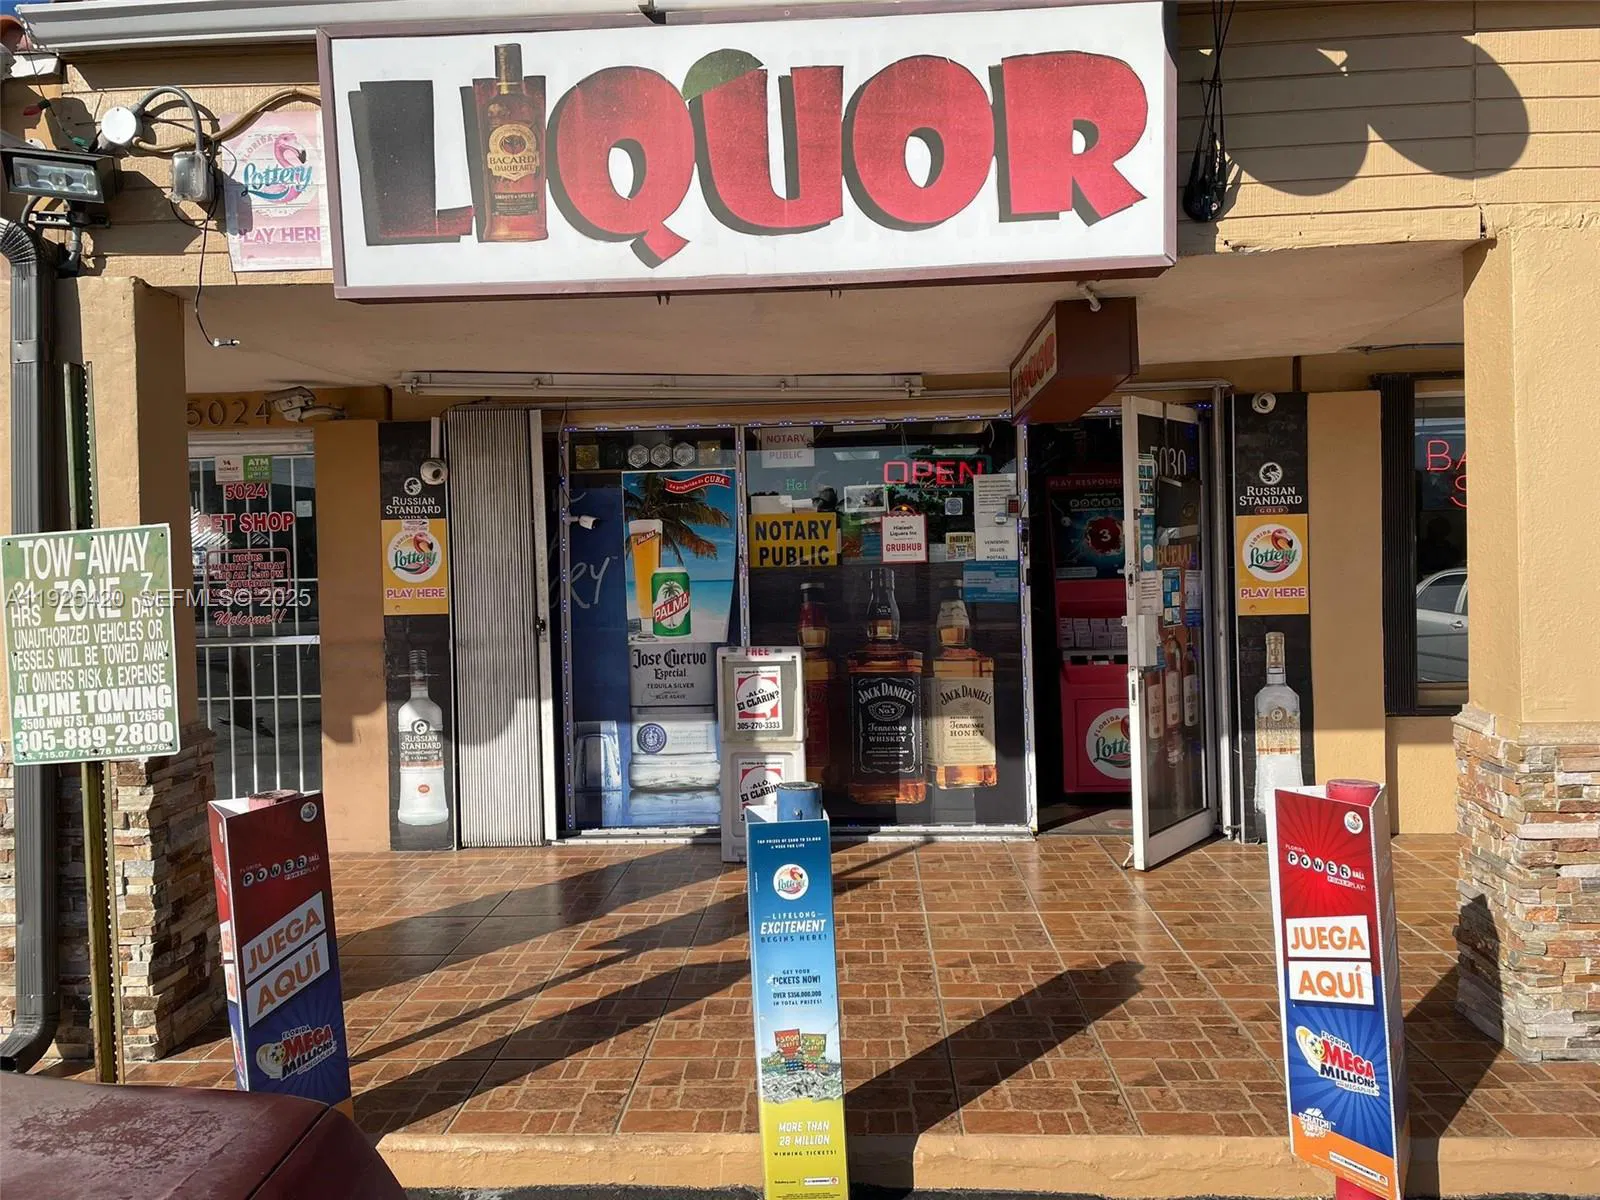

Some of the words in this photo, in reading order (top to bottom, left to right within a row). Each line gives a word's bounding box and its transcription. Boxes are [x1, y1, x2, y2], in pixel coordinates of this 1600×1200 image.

[347, 43, 1149, 268] LIQUOR
[241, 162, 313, 200] Lottery
[186, 399, 271, 427] 5024
[766, 434, 806, 444] NOTARY
[248, 458, 270, 466] ATM
[769, 450, 804, 460] PUBLIC
[704, 475, 725, 484] CUBA
[883, 461, 984, 485] OPEN
[225, 484, 268, 500] 5024
[392, 496, 435, 506] RUSSIAN
[1240, 495, 1302, 506] STANDARD
[1247, 486, 1296, 496] RUSSIAN
[386, 505, 441, 515] STANDARD
[240, 511, 296, 533] SHOP
[755, 520, 832, 541] NOTARY
[1100, 530, 1112, 541] 3
[18, 532, 150, 580] TOW-AWAY
[759, 545, 830, 566] PUBLIC
[886, 543, 922, 552] GRUBHUB
[1248, 547, 1297, 569] Lottery
[392, 550, 438, 573] Lottery
[54, 577, 122, 622] ZONE
[386, 589, 413, 599] PLAY
[416, 587, 445, 598] HERE
[1241, 588, 1270, 599] PLAY
[1274, 587, 1305, 597] HERE
[11, 605, 42, 628] HRS
[654, 591, 690, 622] PALMA
[14, 624, 90, 650] UNAUTHORIZED
[94, 621, 144, 643] VEHICLES
[148, 619, 163, 640] OR
[11, 648, 54, 671] VESSELS
[58, 647, 82, 668] WILL
[85, 646, 99, 666] BE
[102, 643, 138, 665] TOWED
[633, 649, 661, 668] Jose
[663, 648, 707, 668] Cuervo
[17, 674, 29, 694] AT
[32, 670, 74, 692] OWNERS
[78, 668, 103, 690] RISK
[106, 667, 114, 688] &
[118, 663, 166, 687] EXPENSE
[654, 668, 687, 680] Especial
[14, 691, 82, 719] ALPINE
[84, 684, 172, 713] TOWING
[858, 685, 880, 704] JACK
[881, 682, 917, 704] DANIEL'S
[940, 688, 962, 705] JACK
[962, 685, 992, 705] DANIEL'S
[21, 718, 45, 731] 3500
[47, 717, 62, 729] NW
[65, 716, 74, 727] 67
[95, 711, 125, 725] MIAMI
[129, 709, 165, 724] TL2656
[737, 721, 780, 730] 305-270-3333
[1094, 715, 1121, 737] FLORIDA
[15, 721, 174, 752] 305-889-2800
[401, 741, 441, 750] STANDARD
[39, 750, 70, 759] 715.07
[772, 911, 816, 919] LIFELONG
[760, 919, 827, 935] EXCITEMENT
[248, 908, 322, 974] JUEGA
[761, 936, 794, 944] BEGINS
[800, 934, 827, 942] HERE!
[1291, 926, 1366, 951] JUEGA
[256, 943, 321, 1015] AQUÍ
[772, 976, 800, 985] TICKETS
[802, 975, 821, 983] NOW!
[1295, 964, 1365, 1000] AQUÍ
[282, 1026, 312, 1039] FLORIDA
[1322, 1031, 1351, 1050] FLORIDA
[281, 1025, 332, 1064] MEGA
[282, 1040, 333, 1078] MILLIONS
[1322, 1039, 1374, 1079] MEGA
[1320, 1063, 1375, 1088] MILLIONS
[779, 1121, 803, 1133] MORE
[807, 1121, 829, 1131] THAN
[779, 1136, 791, 1146] 28
[794, 1134, 830, 1145] MILLION
